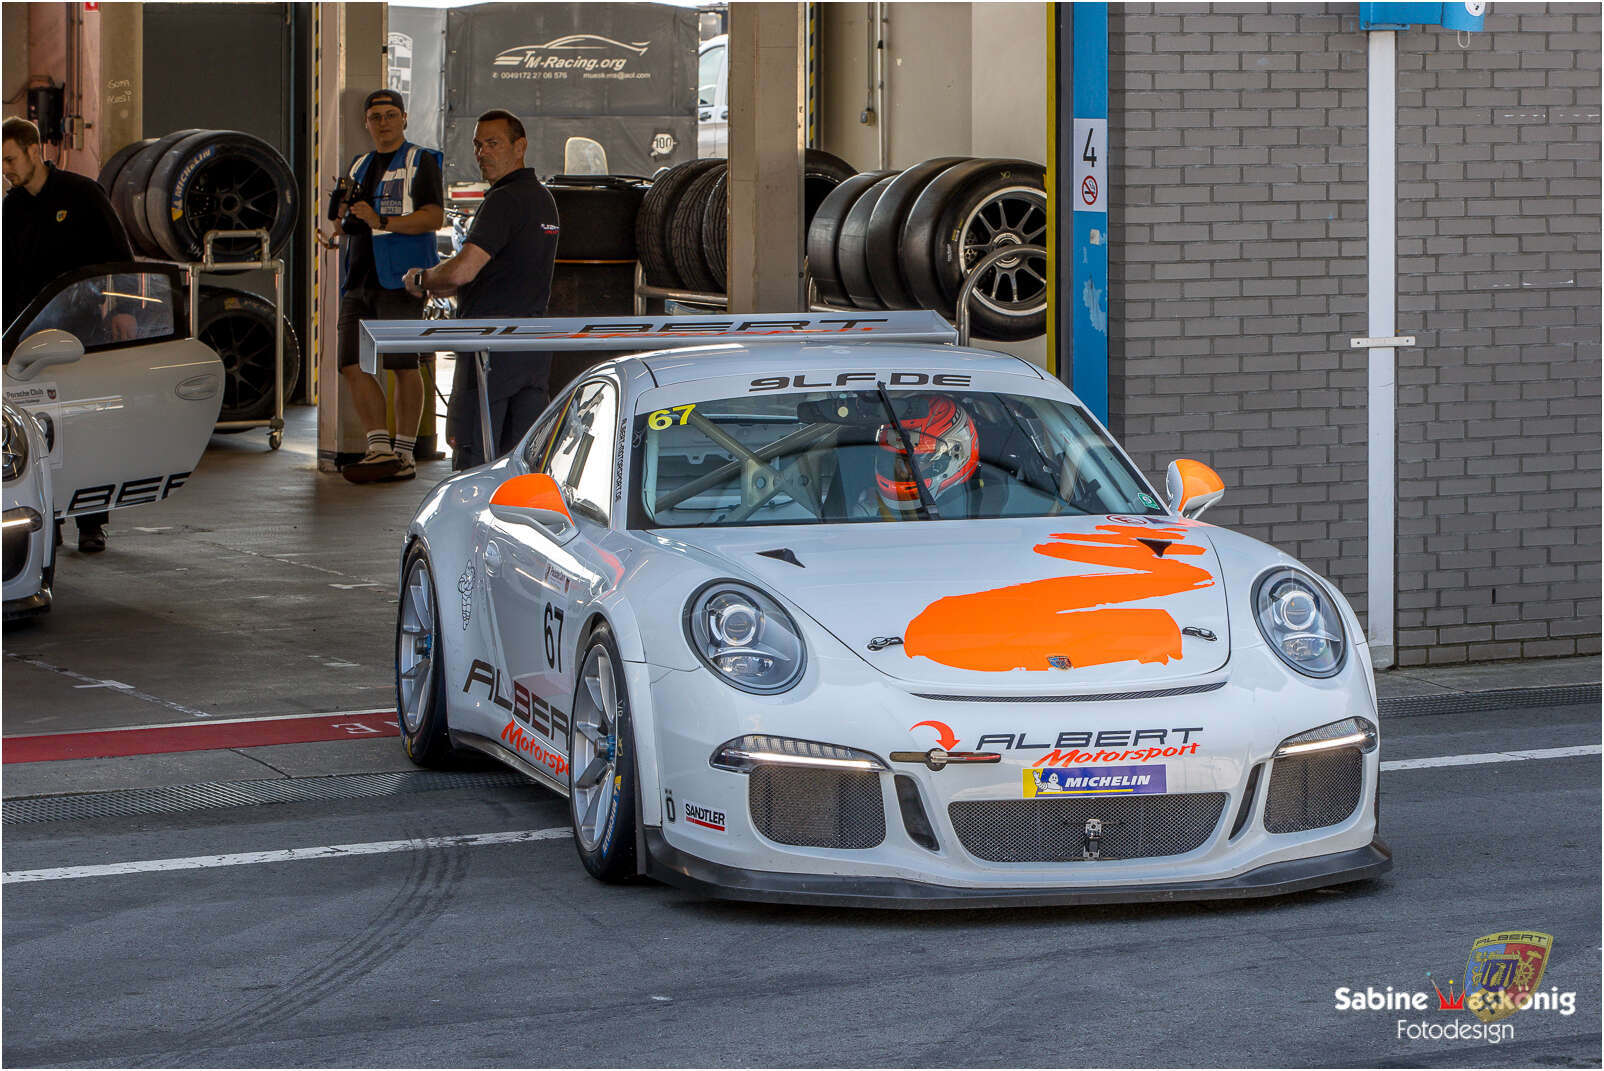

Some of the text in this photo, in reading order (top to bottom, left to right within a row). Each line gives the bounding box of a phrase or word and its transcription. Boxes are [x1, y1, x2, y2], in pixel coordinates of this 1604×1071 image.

[523, 50, 627, 71] TM-Racing.org
[656, 137, 672, 149] 100
[1082, 127, 1098, 168] 4
[418, 318, 889, 337] ALBERT
[647, 403, 698, 430] 67
[544, 601, 565, 673] 67
[462, 658, 570, 751] ALBER
[500, 718, 570, 777] Motorsp
[976, 726, 1204, 750] ALBERT
[1032, 741, 1201, 768] Motorsport
[1064, 774, 1151, 788] MICHELIN
[685, 803, 726, 825] SANDTLER
